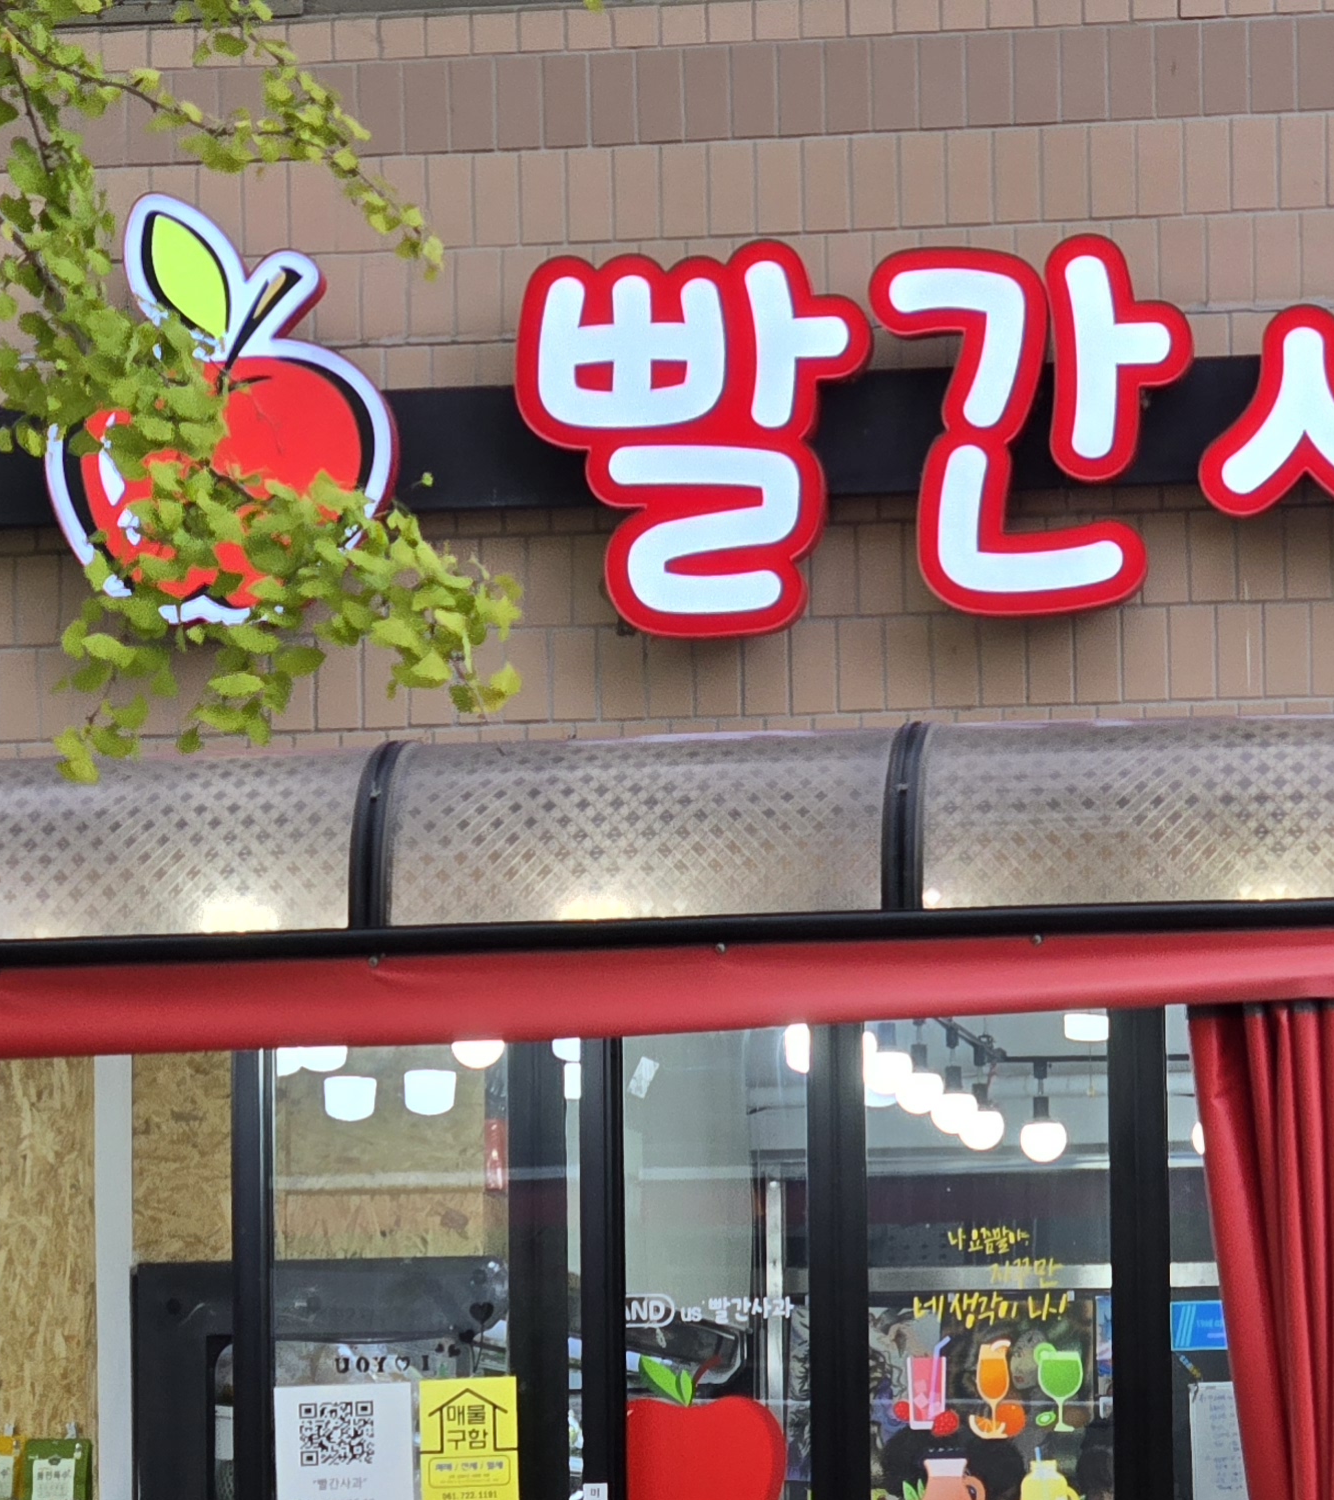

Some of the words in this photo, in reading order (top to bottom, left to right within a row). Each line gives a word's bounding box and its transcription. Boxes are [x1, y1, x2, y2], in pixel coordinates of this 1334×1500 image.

[947, 1227, 966, 1251] 나
[988, 1256, 1064, 1290] 자꾸만
[913, 1294, 945, 1324] 네
[950, 1290, 1018, 1330] 생각이
[447, 1404, 487, 1426] 매물
[447, 1428, 489, 1451] 구함
